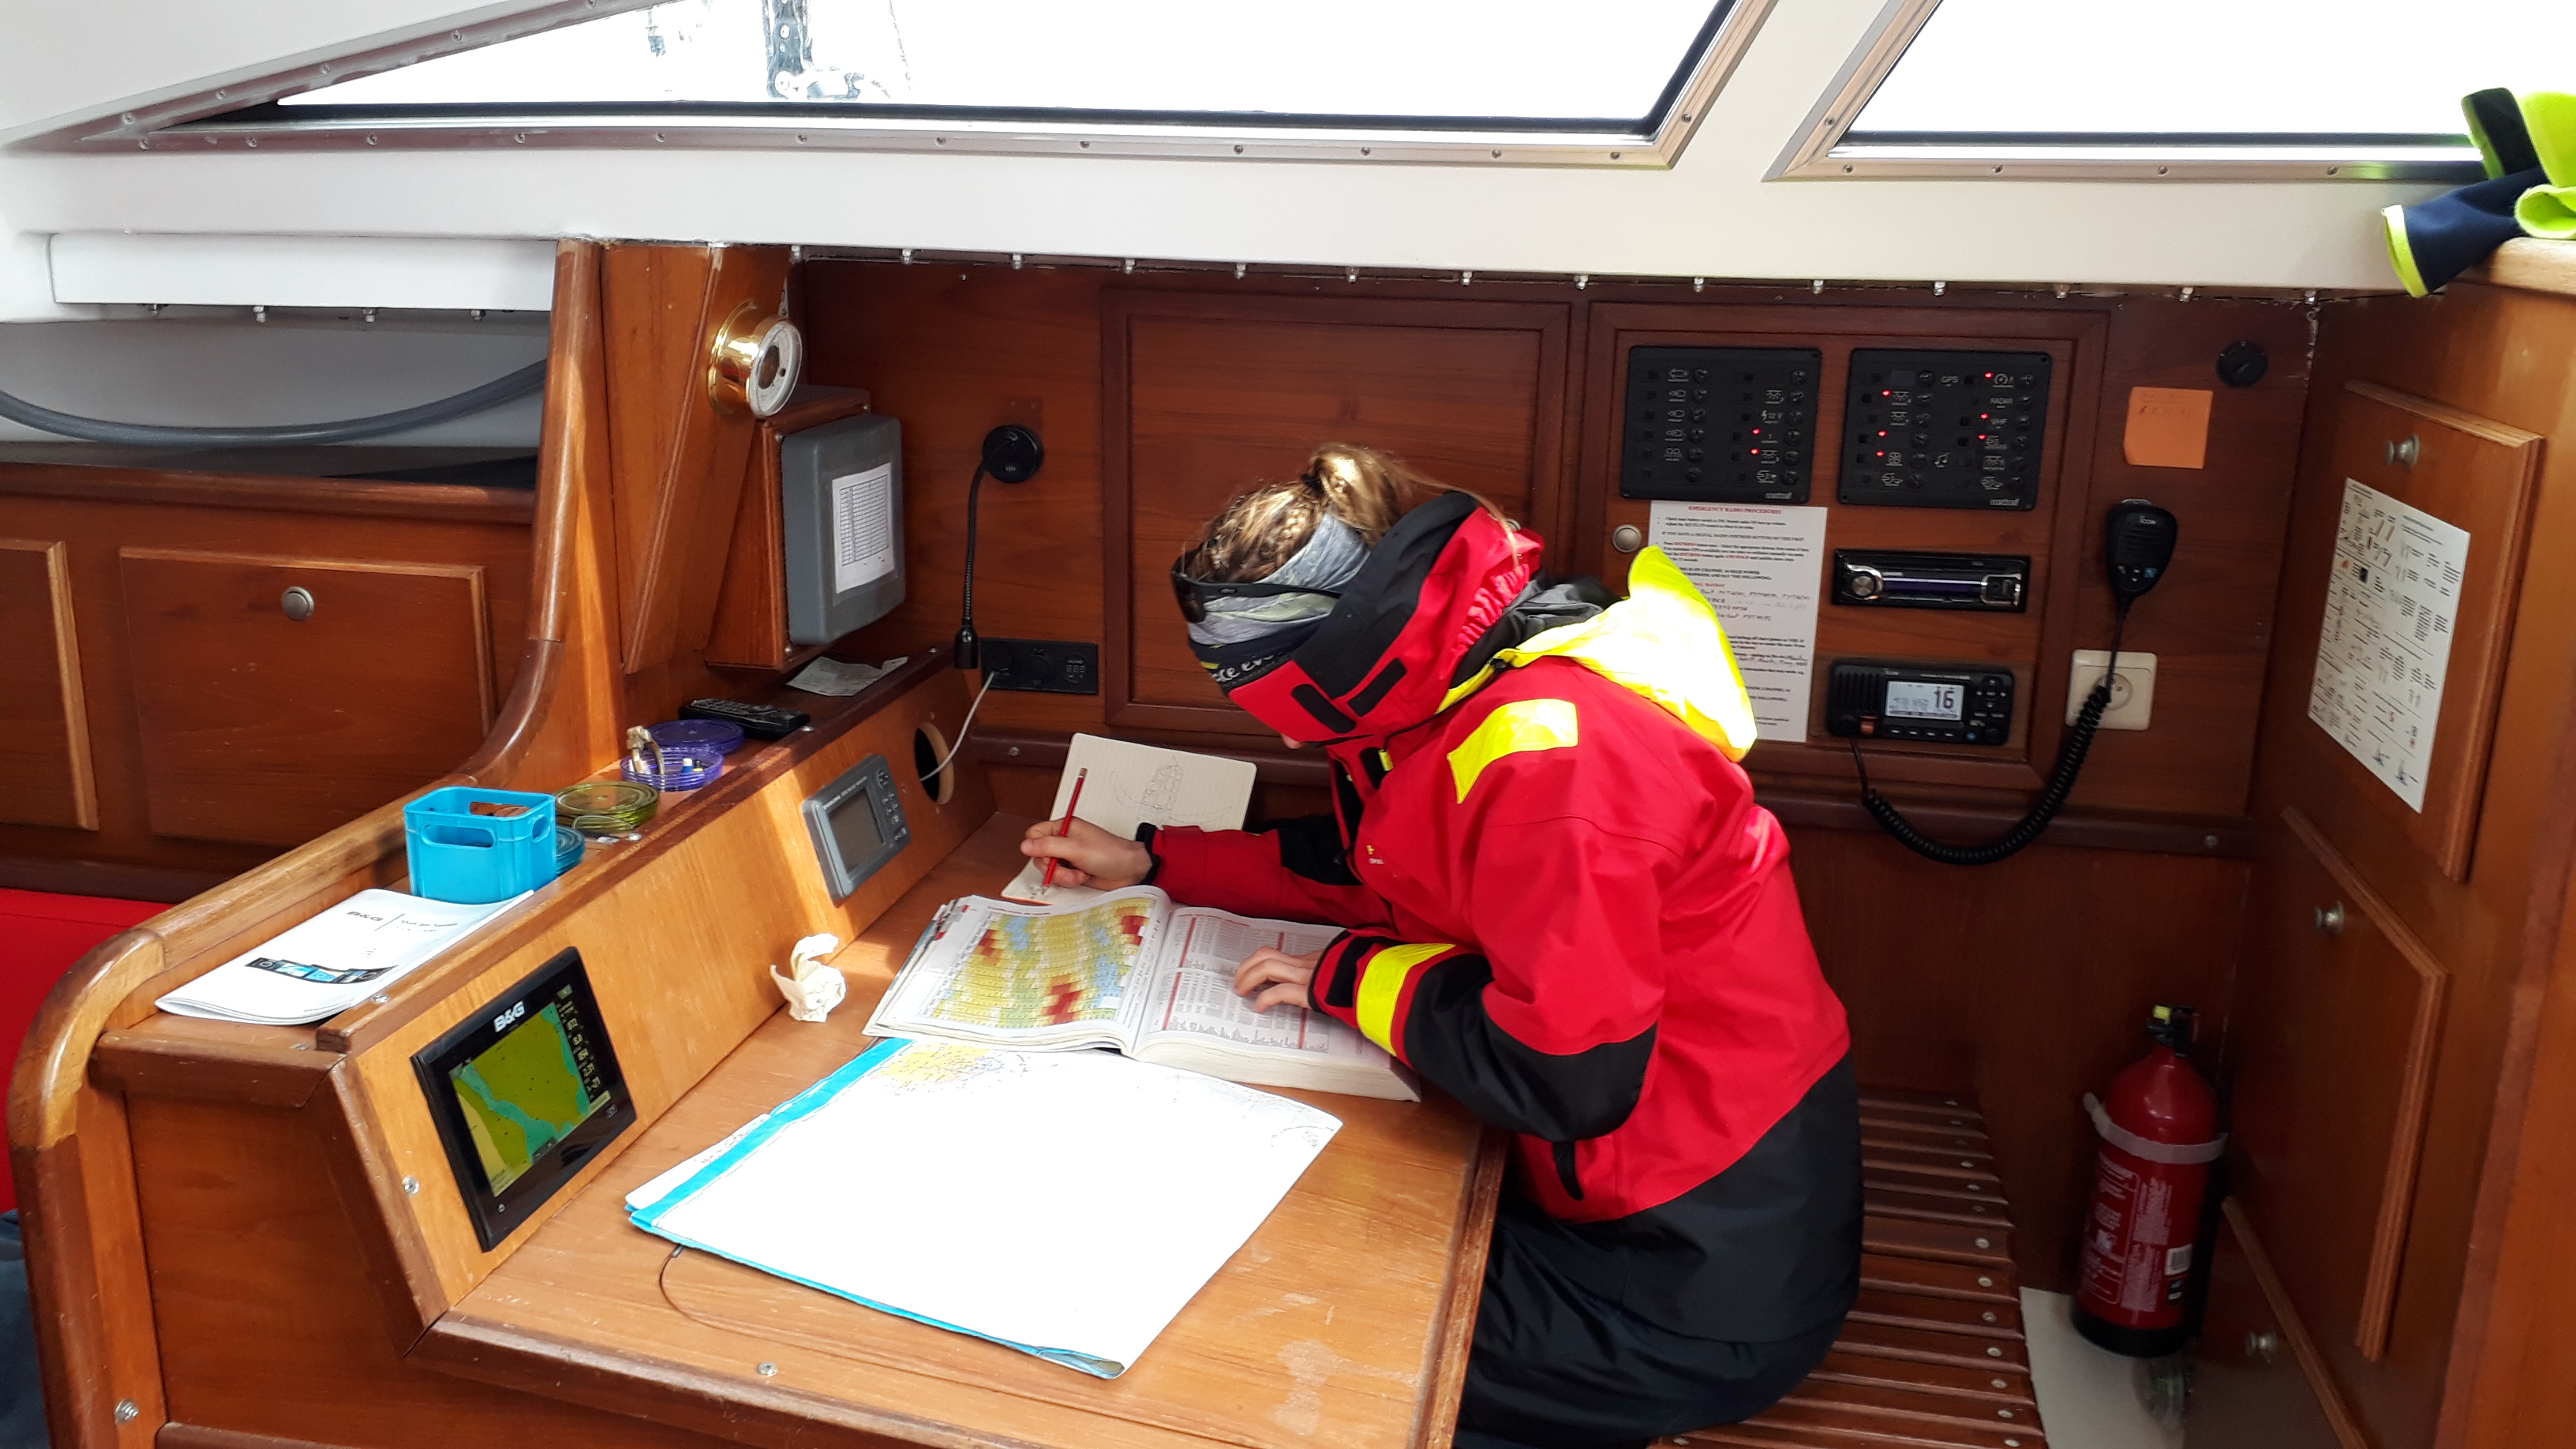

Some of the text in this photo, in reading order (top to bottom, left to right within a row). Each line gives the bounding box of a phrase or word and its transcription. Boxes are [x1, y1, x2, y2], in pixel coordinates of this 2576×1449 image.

[1990, 397, 2014, 406] RADAR
[1933, 690, 1954, 710] 16
[493, 1000, 526, 1033] B&G
